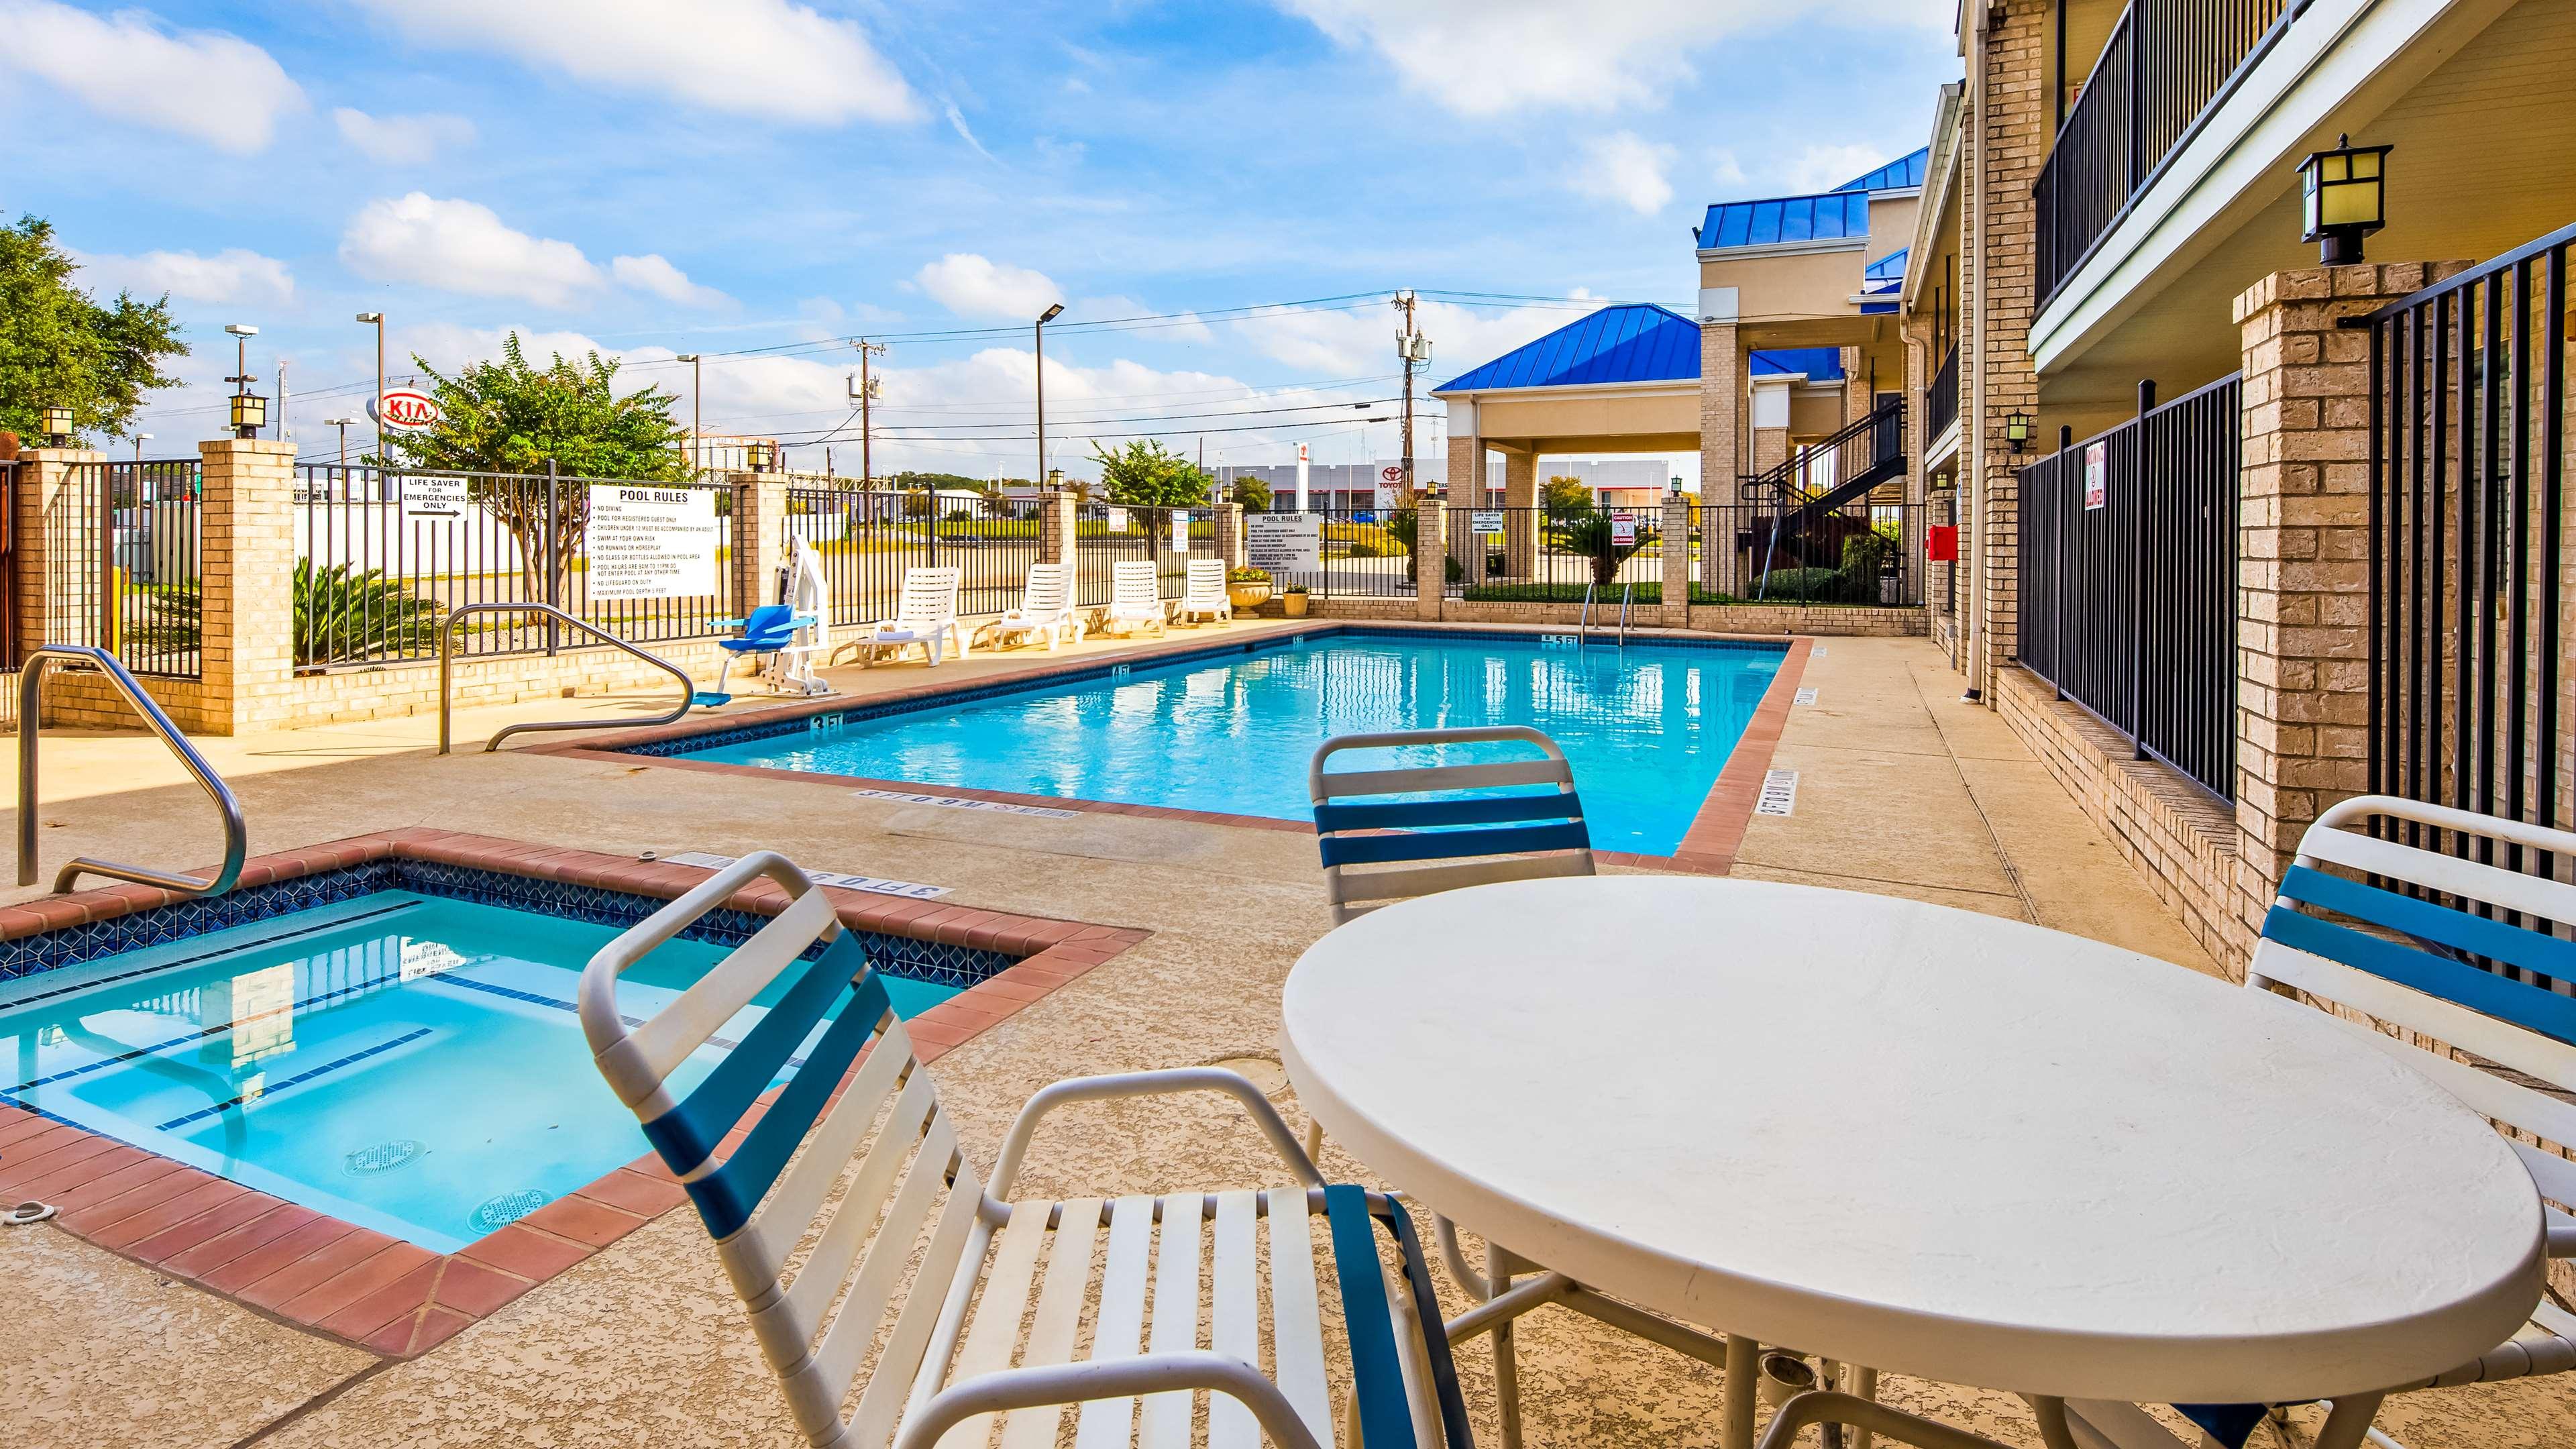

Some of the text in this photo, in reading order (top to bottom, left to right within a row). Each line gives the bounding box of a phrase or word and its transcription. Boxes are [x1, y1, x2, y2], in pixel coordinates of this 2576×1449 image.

[390, 400, 428, 419] KIA
[404, 494, 466, 502] EMERGENCIES
[620, 490, 688, 502] POOL RULES
[1556, 636, 1576, 645] 5 FT
[1114, 665, 1128, 676] 4 FT
[813, 714, 841, 730] 3 FT
[865, 881, 912, 892] FT
[910, 887, 940, 895] 3
